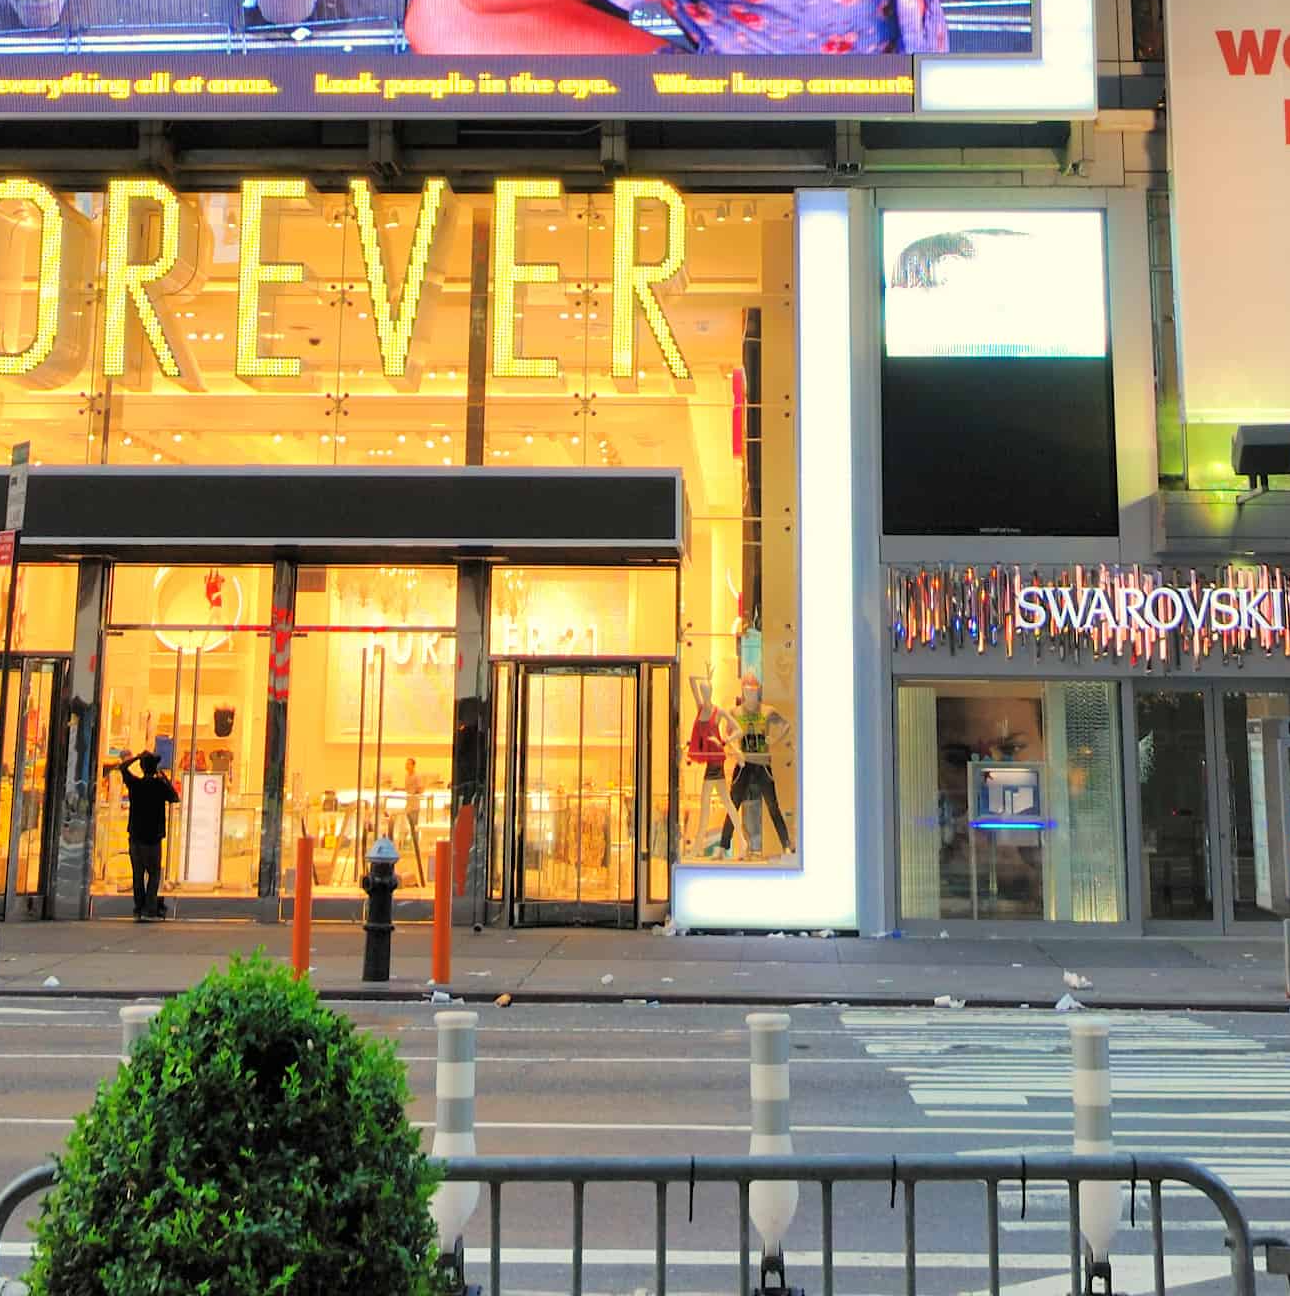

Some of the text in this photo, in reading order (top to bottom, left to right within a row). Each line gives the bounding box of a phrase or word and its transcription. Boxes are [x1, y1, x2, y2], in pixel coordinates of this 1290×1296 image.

[383, 71, 475, 100] people
[478, 72, 506, 94] in
[509, 71, 555, 94] the
[1017, 587, 1286, 631] SWAROVSKI
